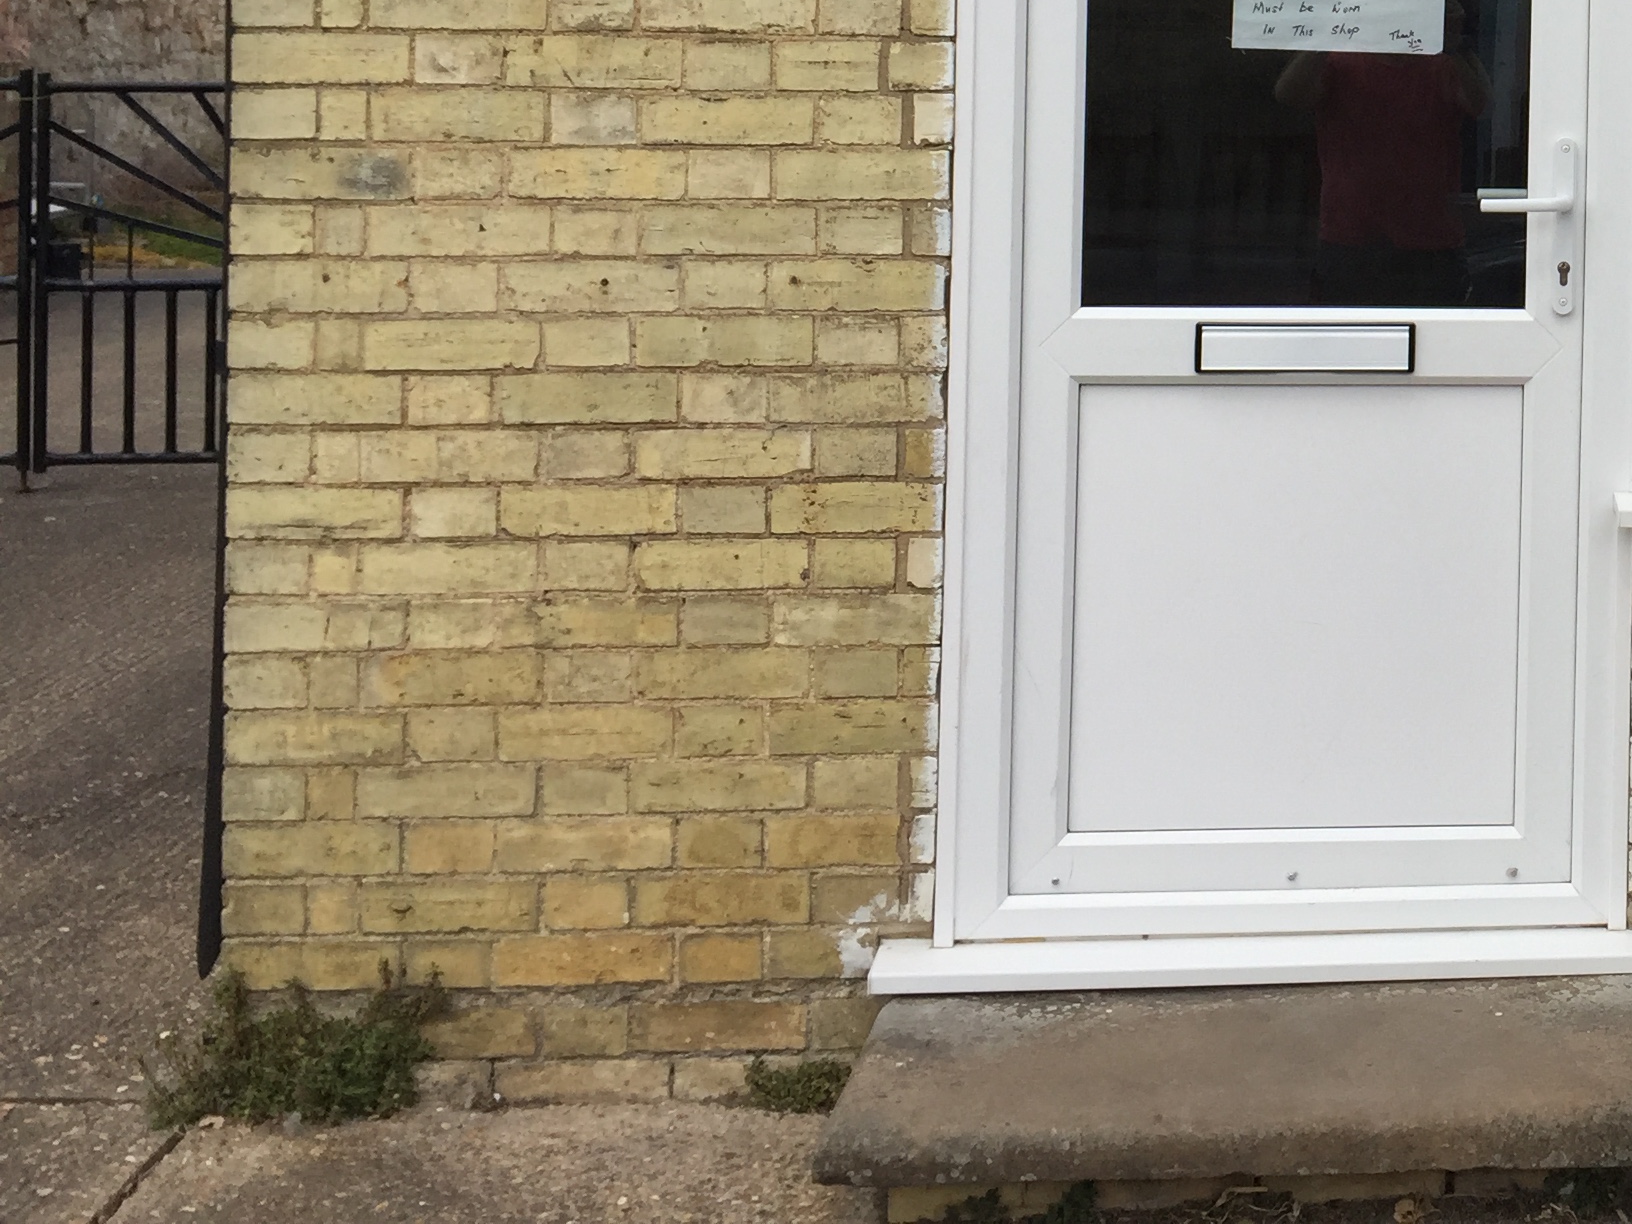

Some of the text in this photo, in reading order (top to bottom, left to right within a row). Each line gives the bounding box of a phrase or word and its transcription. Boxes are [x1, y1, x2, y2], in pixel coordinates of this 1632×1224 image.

[1252, 1, 1285, 14] Must
[1299, 1, 1315, 13] be
[1292, 25, 1314, 36] This
